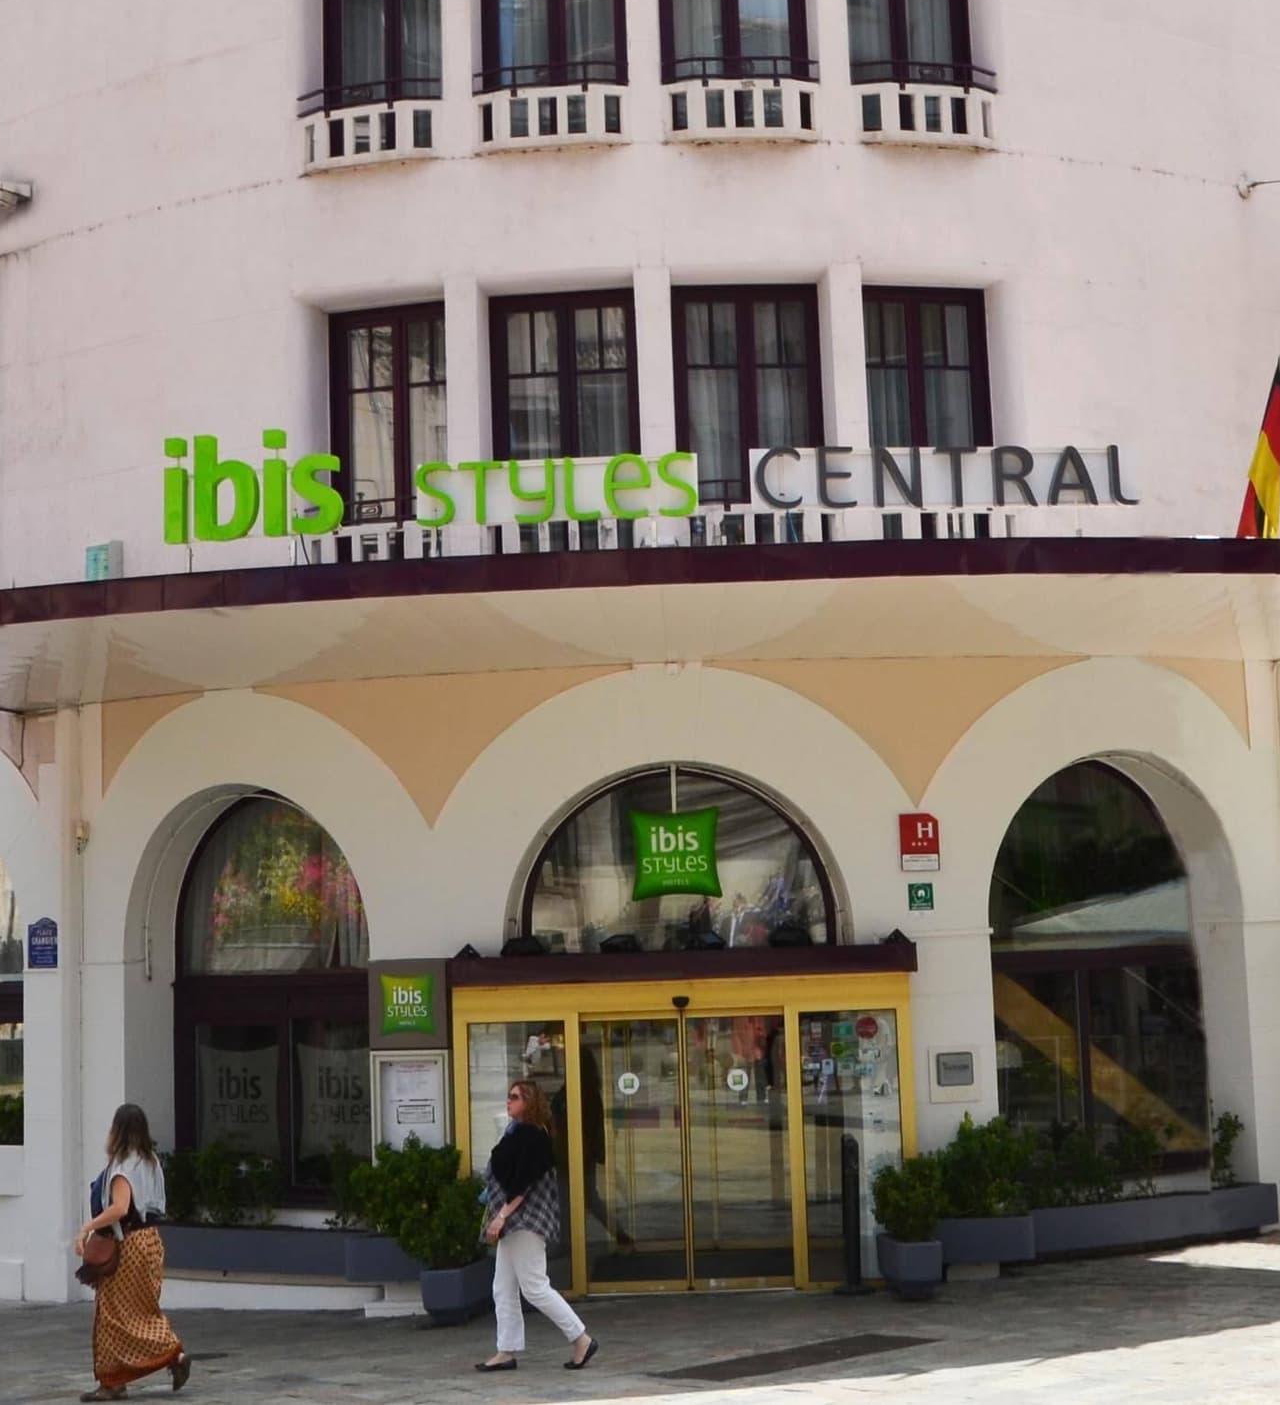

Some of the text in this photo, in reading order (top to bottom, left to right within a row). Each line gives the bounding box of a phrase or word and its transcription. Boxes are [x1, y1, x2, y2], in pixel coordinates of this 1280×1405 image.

[164, 429, 1140, 544] ibis STYLES CENTRAL
[650, 825, 700, 854] ibis
[917, 822, 933, 838] H
[642, 854, 708, 874] STYLES
[392, 985, 423, 1005] ibis
[219, 1067, 262, 1100] ibis
[318, 1066, 364, 1100] ibis
